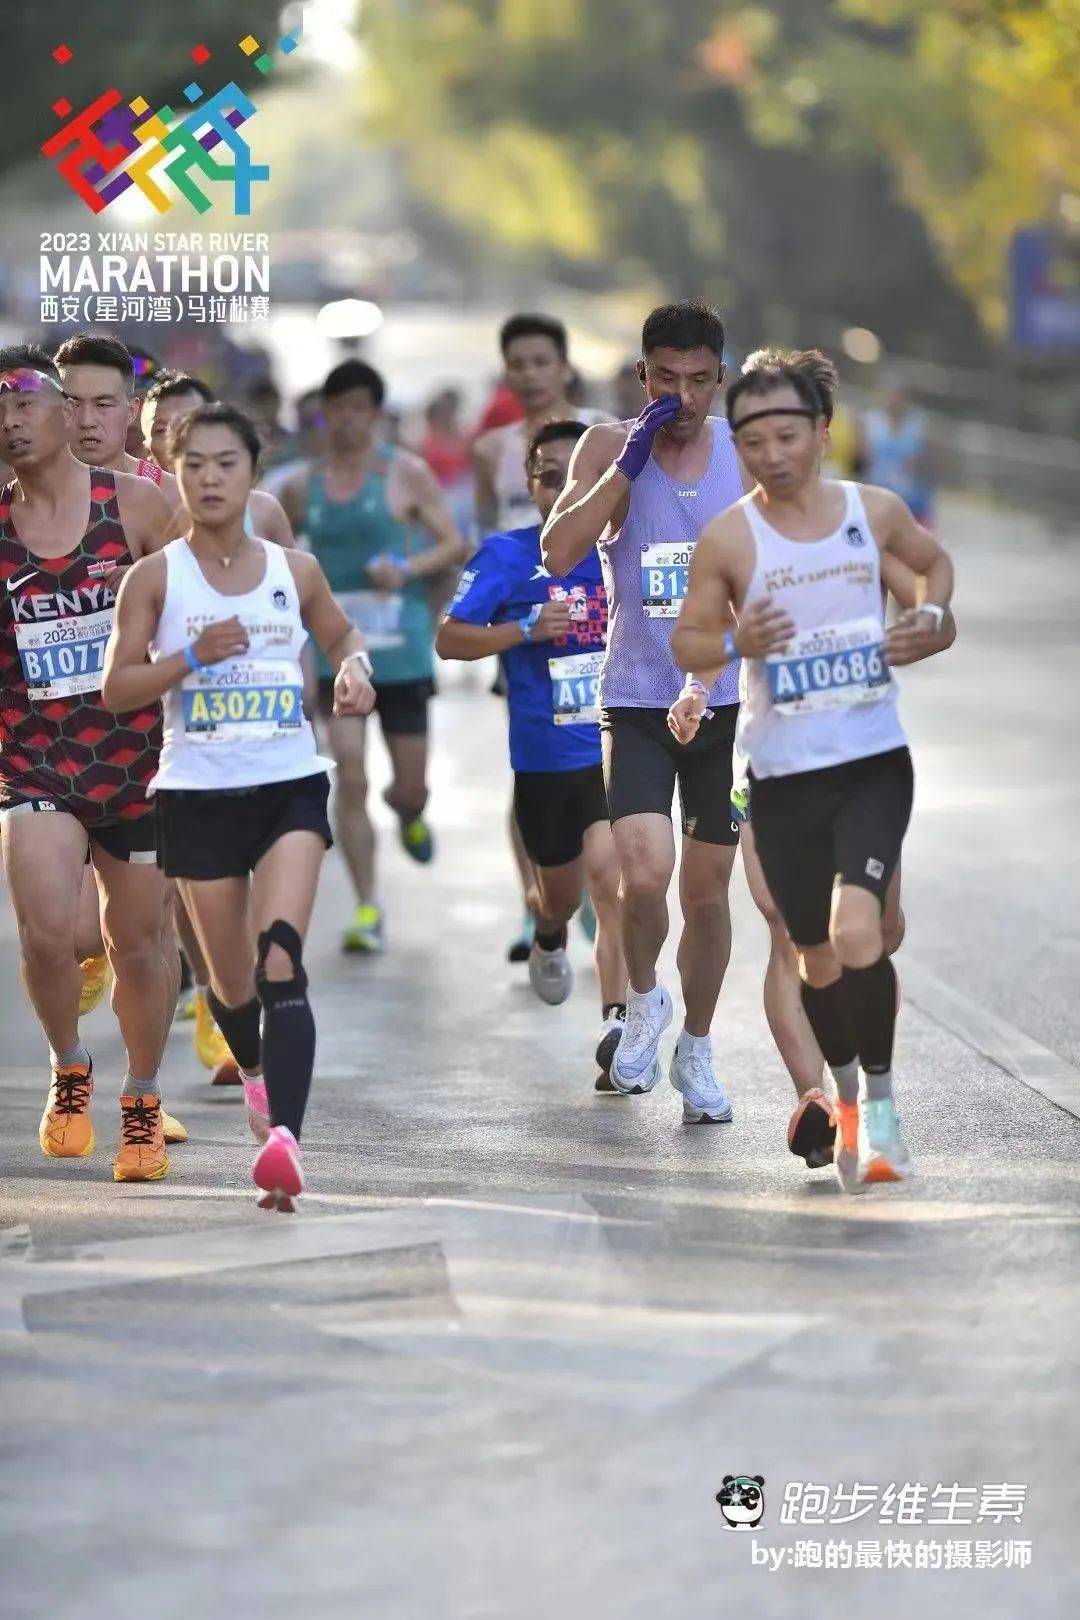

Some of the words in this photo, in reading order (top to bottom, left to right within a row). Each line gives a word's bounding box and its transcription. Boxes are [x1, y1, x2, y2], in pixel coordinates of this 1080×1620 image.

[11, 583, 117, 622] KENYA
[43, 627, 76, 645] 2023
[776, 646, 882, 697] A10686
[191, 688, 296, 722] A30279
